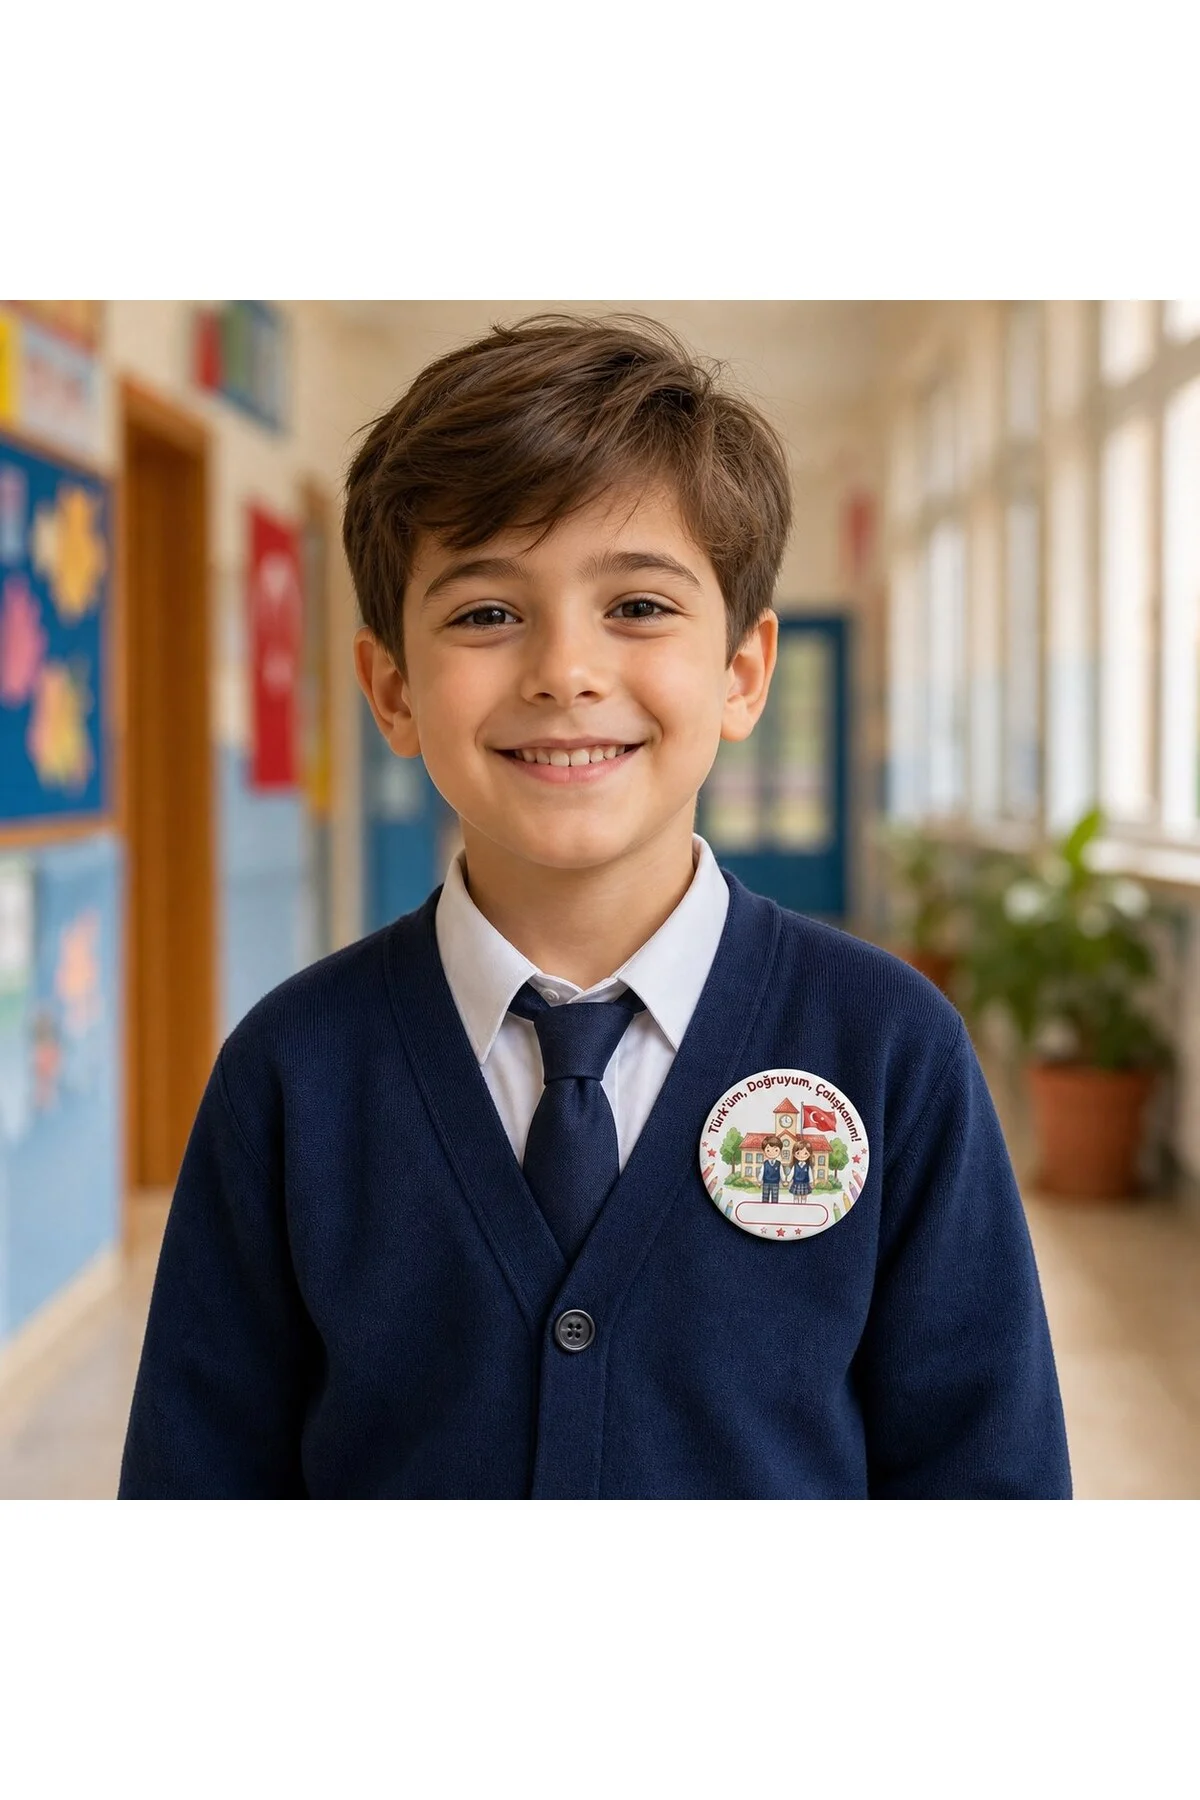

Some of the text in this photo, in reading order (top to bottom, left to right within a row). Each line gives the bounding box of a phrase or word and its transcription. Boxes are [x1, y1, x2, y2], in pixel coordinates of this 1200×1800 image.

[708, 1075, 862, 1143] Türk'üm, Doğruyum, Çalışkanım!
